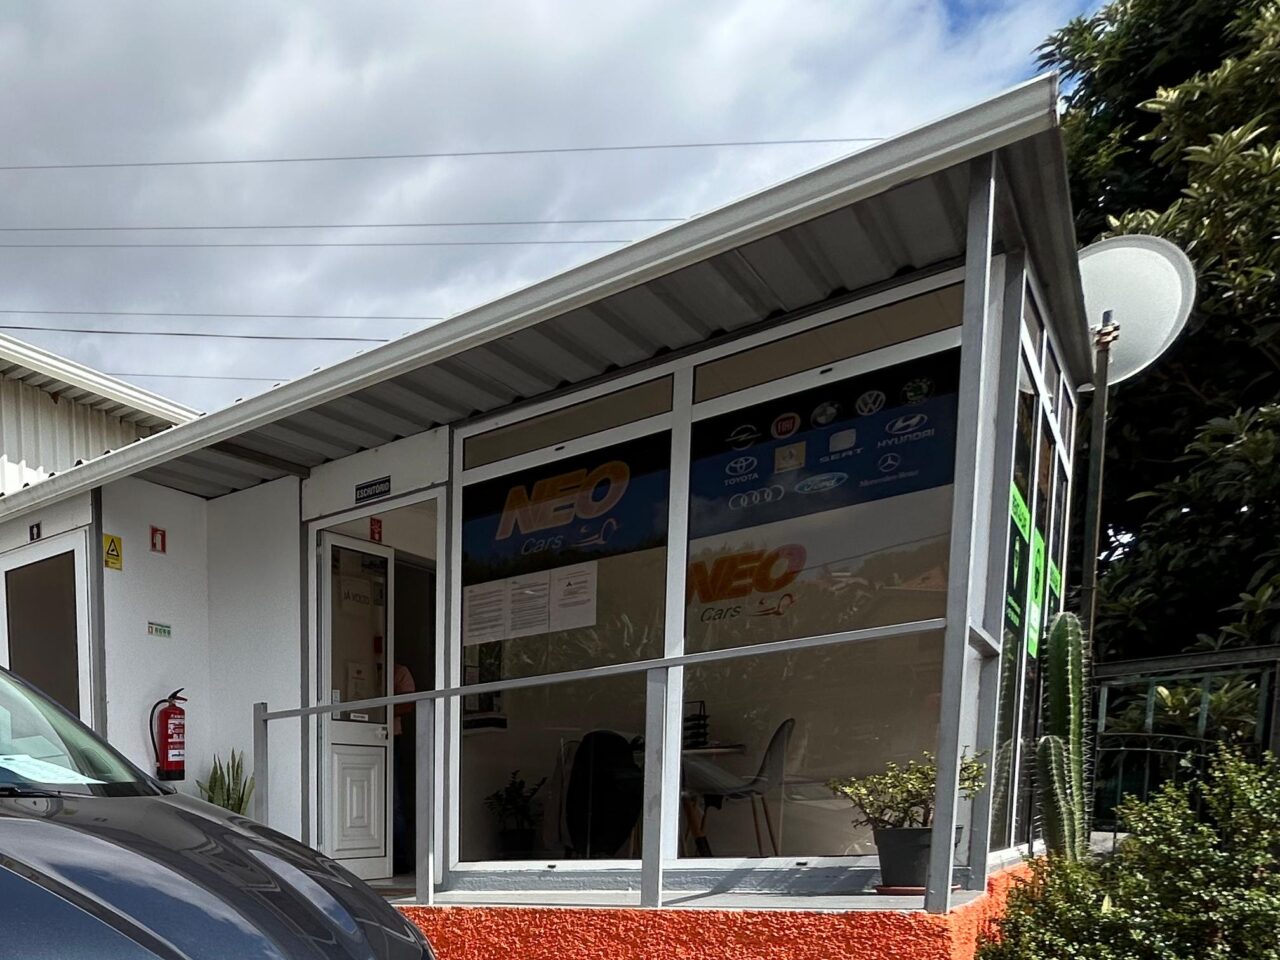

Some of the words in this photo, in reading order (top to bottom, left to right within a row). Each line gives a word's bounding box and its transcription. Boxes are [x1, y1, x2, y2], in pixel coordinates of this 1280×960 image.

[877, 428, 935, 449] HYUNDAI
[819, 447, 864, 463] SEAT
[724, 473, 759, 486] TOYOTA
[495, 460, 630, 540] NEO
[521, 534, 564, 555] Cars
[688, 543, 807, 605] NEO
[701, 605, 742, 622] Cars
